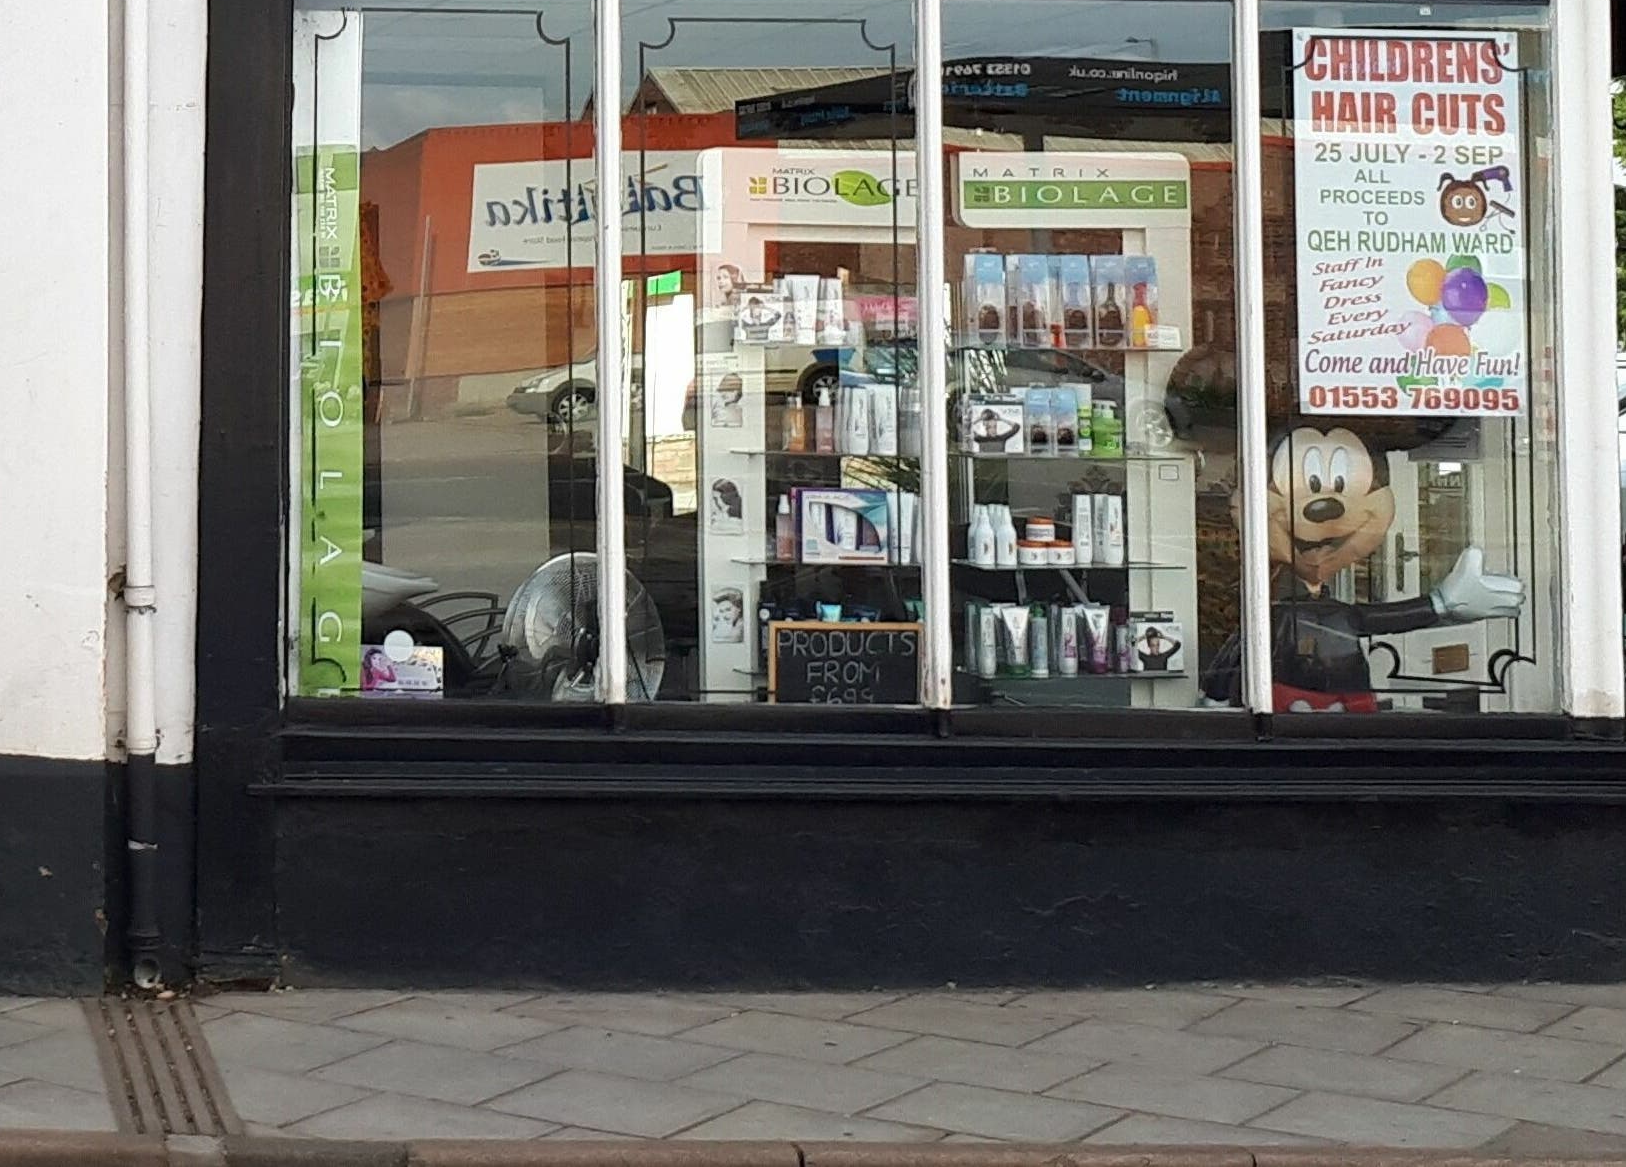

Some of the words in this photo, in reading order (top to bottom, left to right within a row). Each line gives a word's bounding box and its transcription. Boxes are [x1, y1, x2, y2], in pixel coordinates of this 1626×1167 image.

[1304, 39, 1510, 85] CHILDRENS'
[1311, 90, 1397, 134] HAIR
[1411, 92, 1506, 136] CUTS
[1314, 142, 1342, 163] 25
[1349, 143, 1411, 164] JULY
[1433, 145, 1447, 164] 2
[1454, 145, 1504, 165] SEP
[972, 168, 1110, 178] MATRIX
[1354, 169, 1391, 184] ALL
[324, 167, 338, 240] MATRIX
[994, 185, 1179, 204] BIOLAGE
[1320, 189, 1425, 206] PROCEEDS
[1363, 211, 1389, 226] TO
[1307, 230, 1350, 253] QEH
[1358, 231, 1446, 253] RUDHAM
[1452, 233, 1514, 254] WARD
[1312, 257, 1362, 276] Staff
[1319, 275, 1384, 293] Fancy
[1324, 292, 1383, 309] Dress
[1327, 308, 1389, 326] Every
[1307, 321, 1412, 345] Saturday
[1304, 349, 1363, 374] Come
[1368, 352, 1410, 374] and
[1415, 348, 1469, 376] Have
[1475, 352, 1521, 376] Fun!
[1308, 385, 1399, 410] 01553
[1409, 387, 1520, 411] 769095
[777, 631, 916, 657] PRODUCTS
[807, 661, 880, 684] FROM
